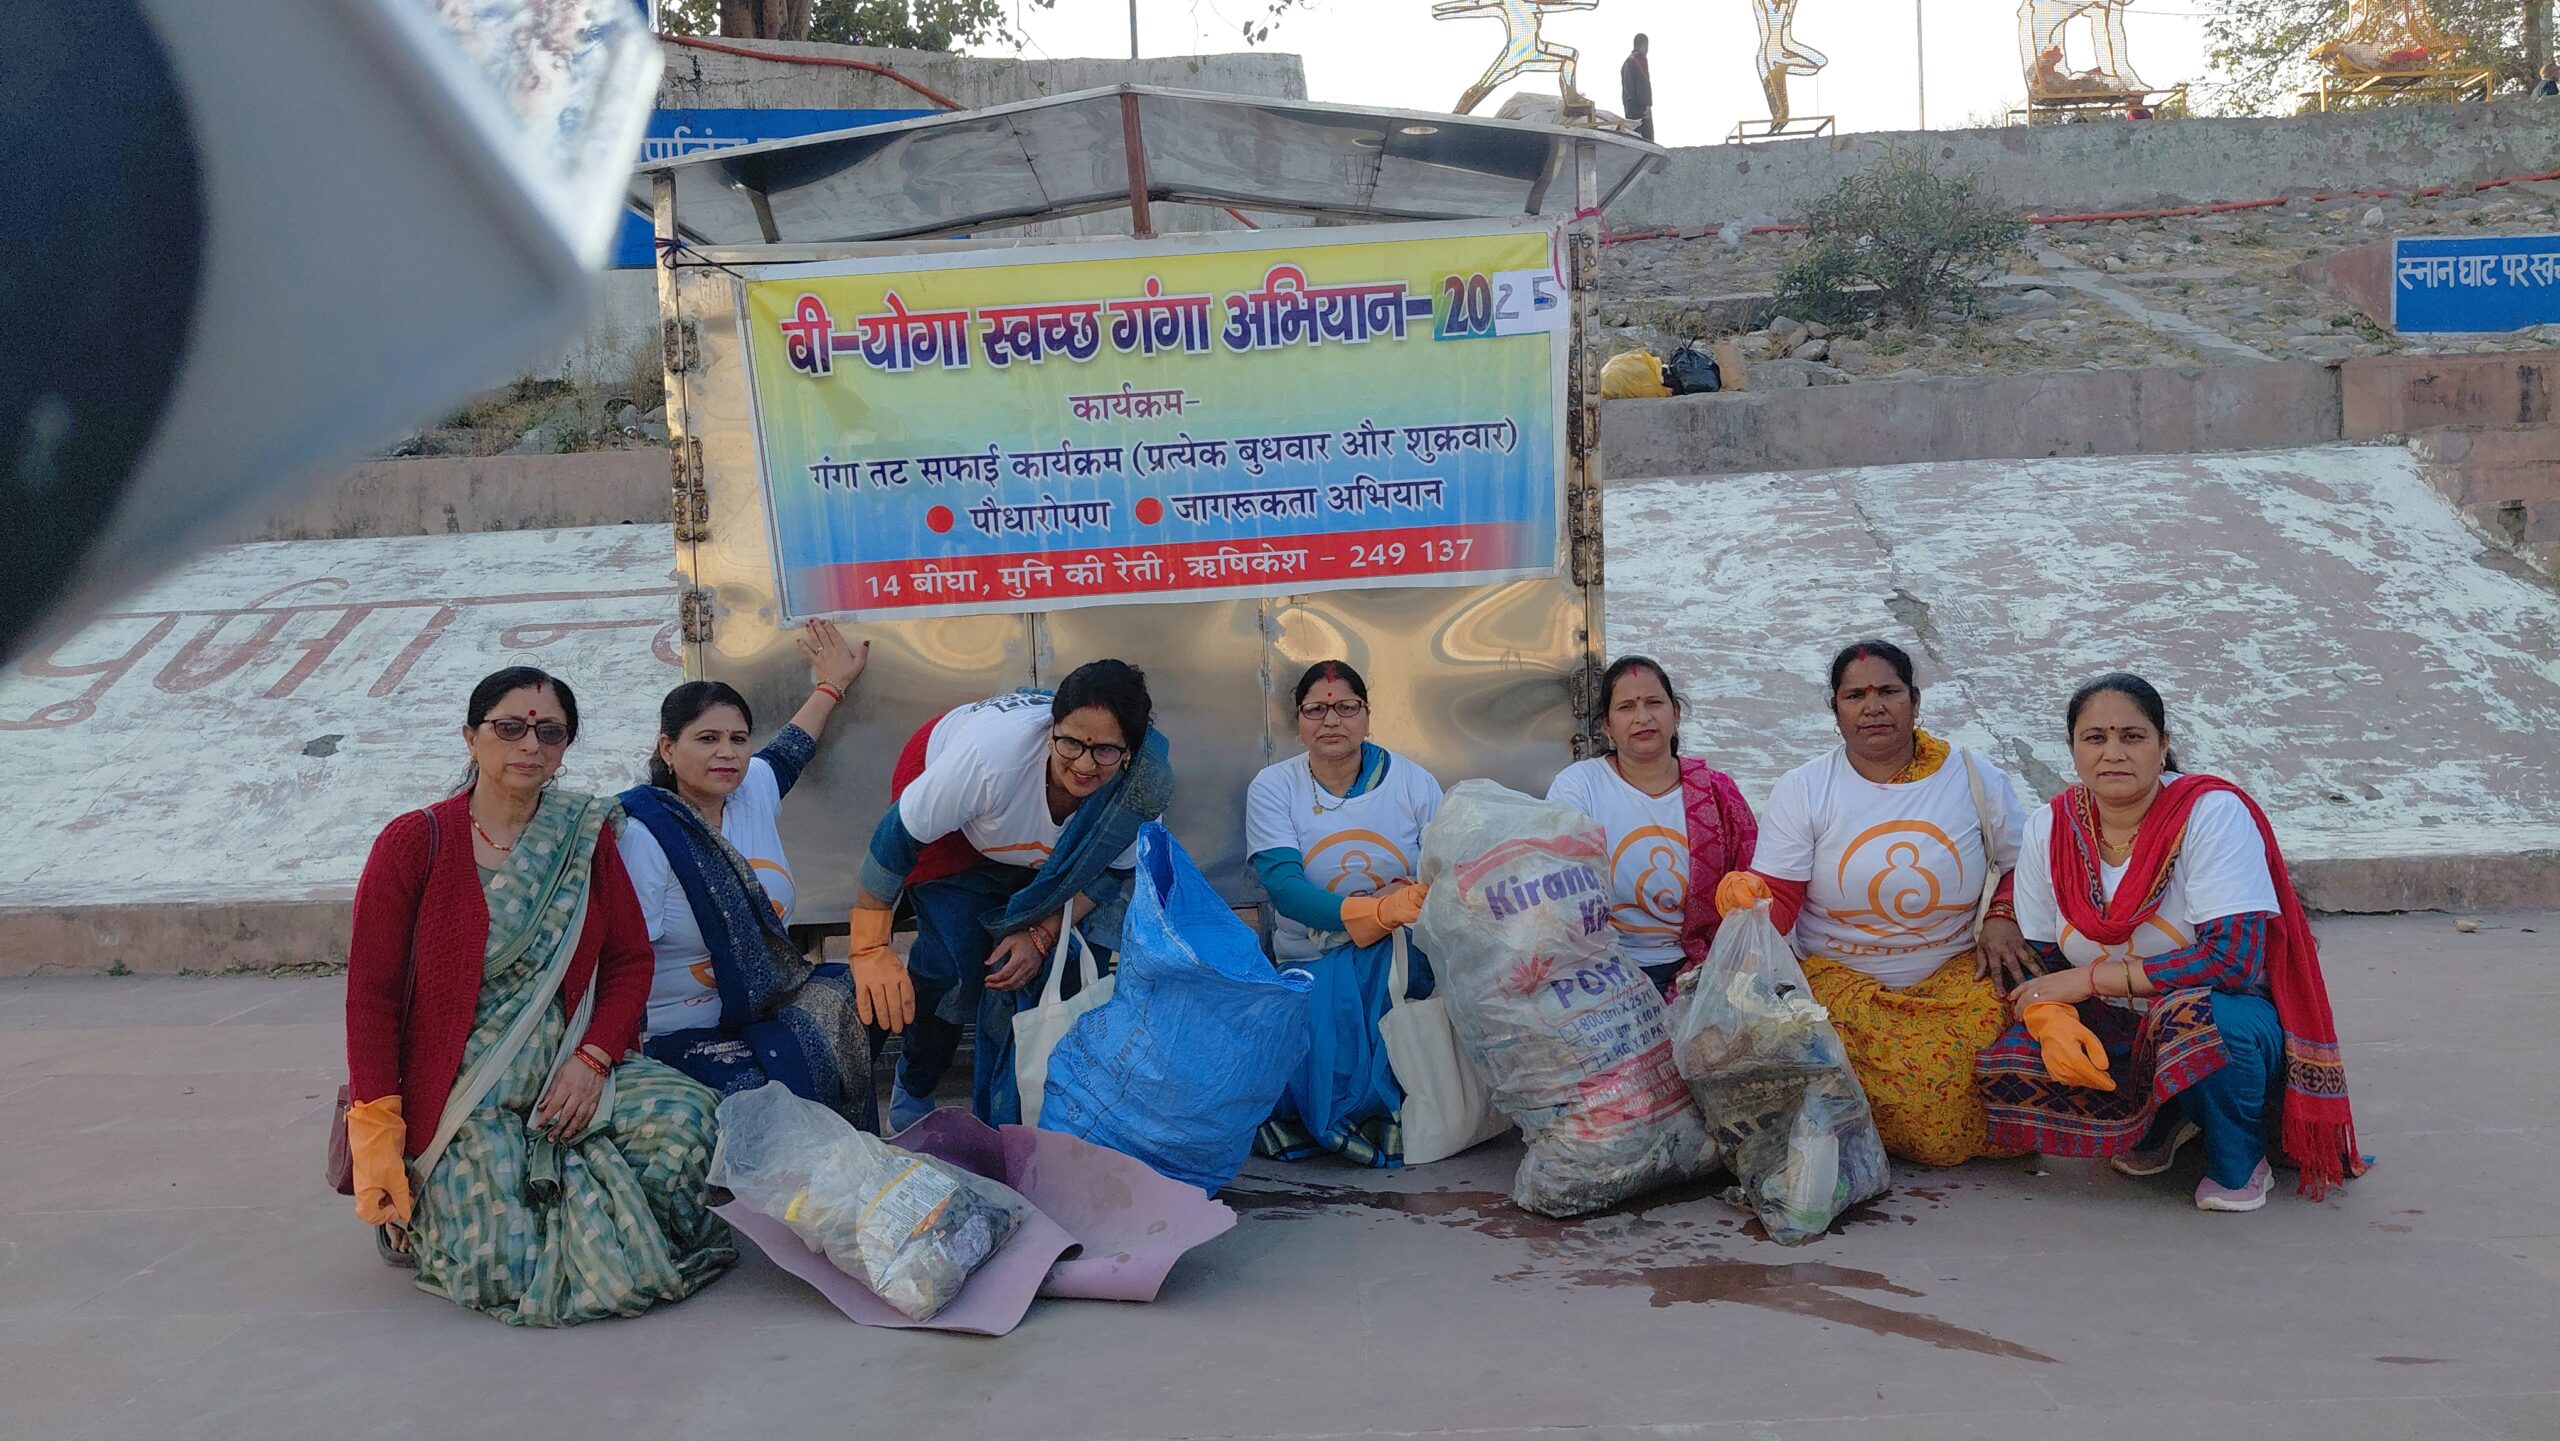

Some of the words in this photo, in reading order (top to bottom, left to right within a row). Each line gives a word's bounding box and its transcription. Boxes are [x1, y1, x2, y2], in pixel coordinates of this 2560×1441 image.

[2398, 256, 2456, 290] स्नान
[2458, 255, 2499, 288] घाट
[2501, 254, 2530, 288] पर
[977, 301, 1103, 368] स्वच्छ
[1106, 275, 1213, 354] गंगा
[1069, 383, 1199, 421] कार्यक्रम-
[810, 456, 859, 489] गंगा
[866, 460, 909, 487] तट
[917, 444, 1001, 487] सफाई
[1008, 440, 1123, 479] कार्यक्रम
[1132, 433, 1227, 476] (प्रत्येक
[1236, 431, 1331, 474] बुधवार
[1342, 419, 1395, 455] और
[1404, 417, 1518, 463] शुक्रवार)
[969, 495, 1112, 534] पौधारोपण
[1171, 487, 1317, 522] जागरूकता
[1327, 476, 1443, 511] अभियान
[865, 576, 900, 597] 14
[997, 559, 1054, 597] मुनि
[1062, 555, 1104, 587] की
[1112, 552, 1175, 583] रेती,
[1183, 544, 1308, 579] ऋषिकेश
[1350, 543, 1406, 568] 249
[1421, 538, 1474, 563] 137
[1590, 1028, 1614, 1046] 500
